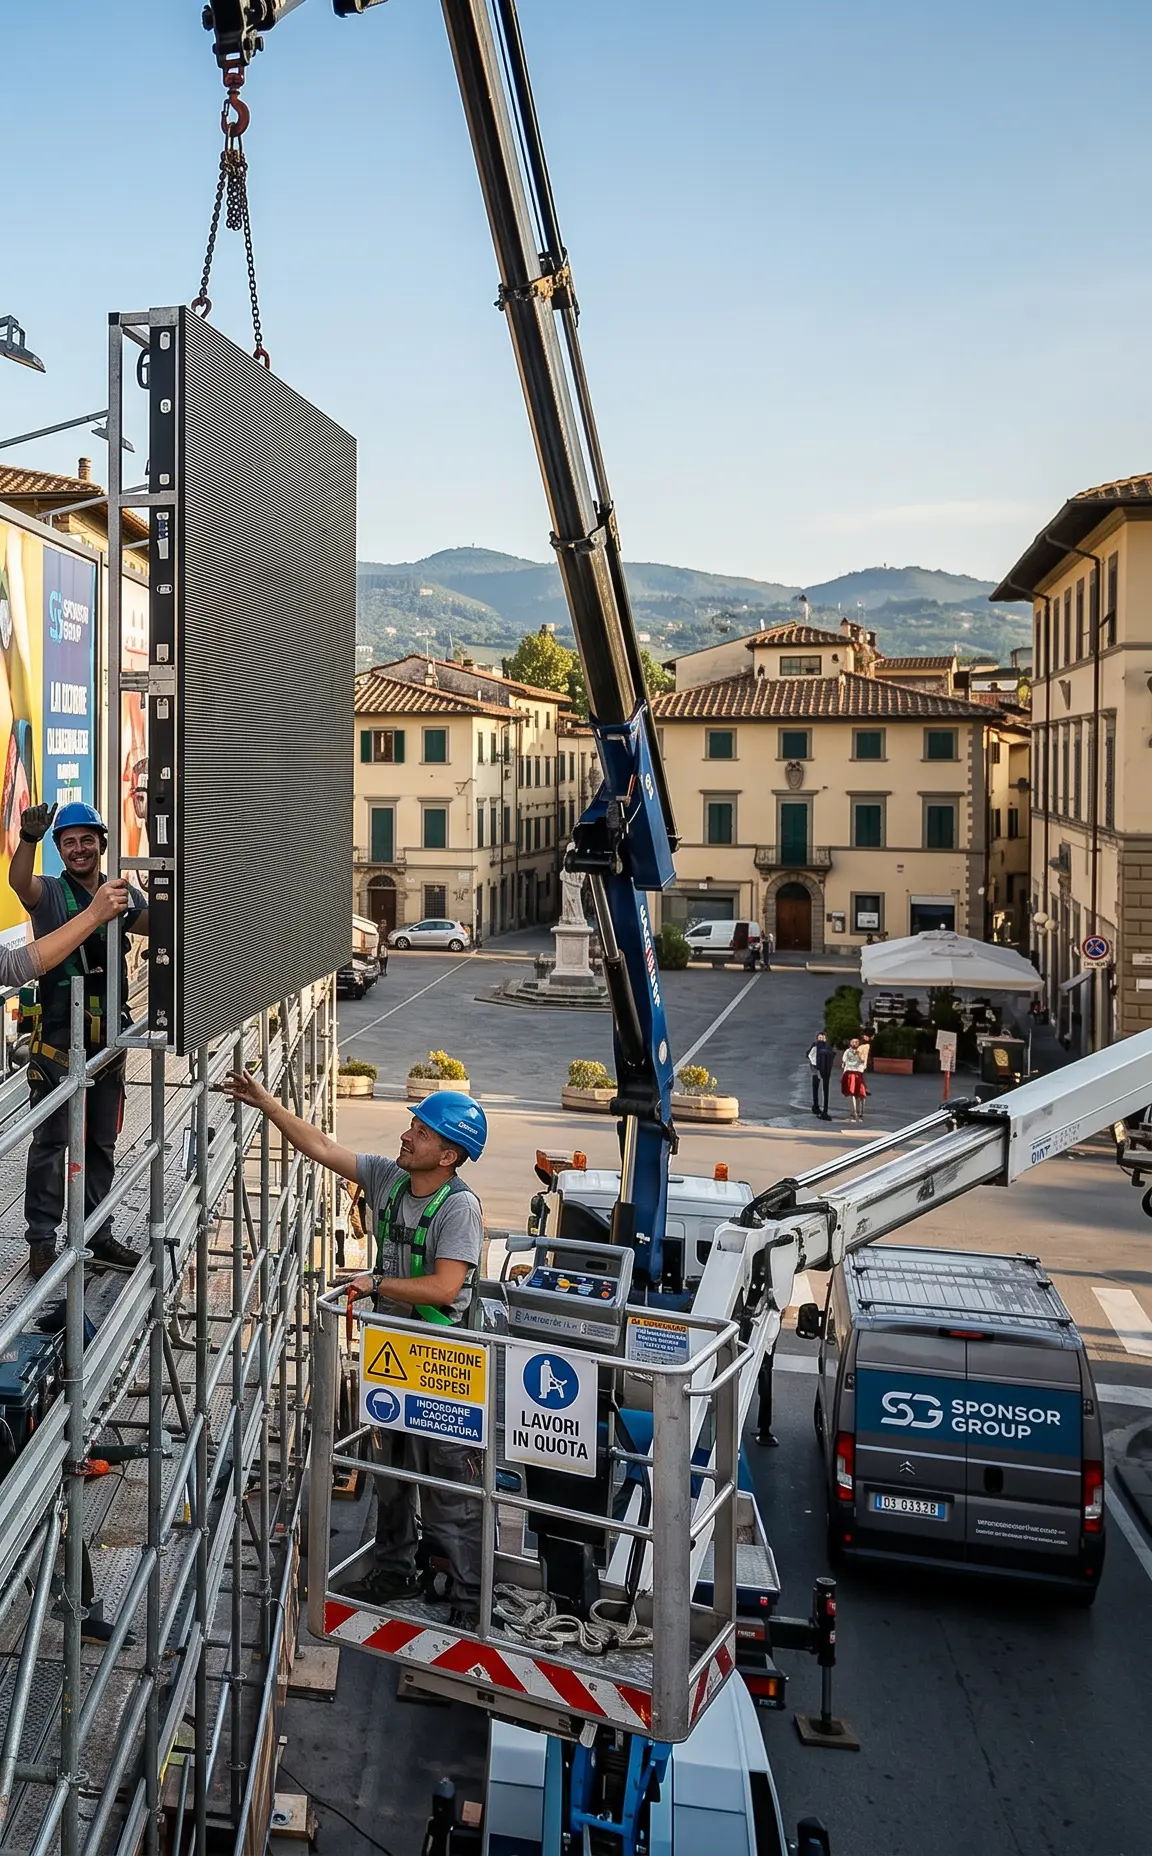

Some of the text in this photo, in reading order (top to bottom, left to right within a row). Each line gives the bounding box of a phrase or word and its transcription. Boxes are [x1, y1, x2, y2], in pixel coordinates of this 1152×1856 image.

[409, 1343, 482, 1368] ATTENZIONE
[419, 1375, 470, 1395] SOSPESI
[458, 1416, 464, 1426] E
[521, 1410, 580, 1437] LAVORI
[951, 1399, 1061, 1426] SPONSOR
[951, 1417, 1032, 1440] GROUP
[513, 1429, 588, 1460] IN QUOTA
